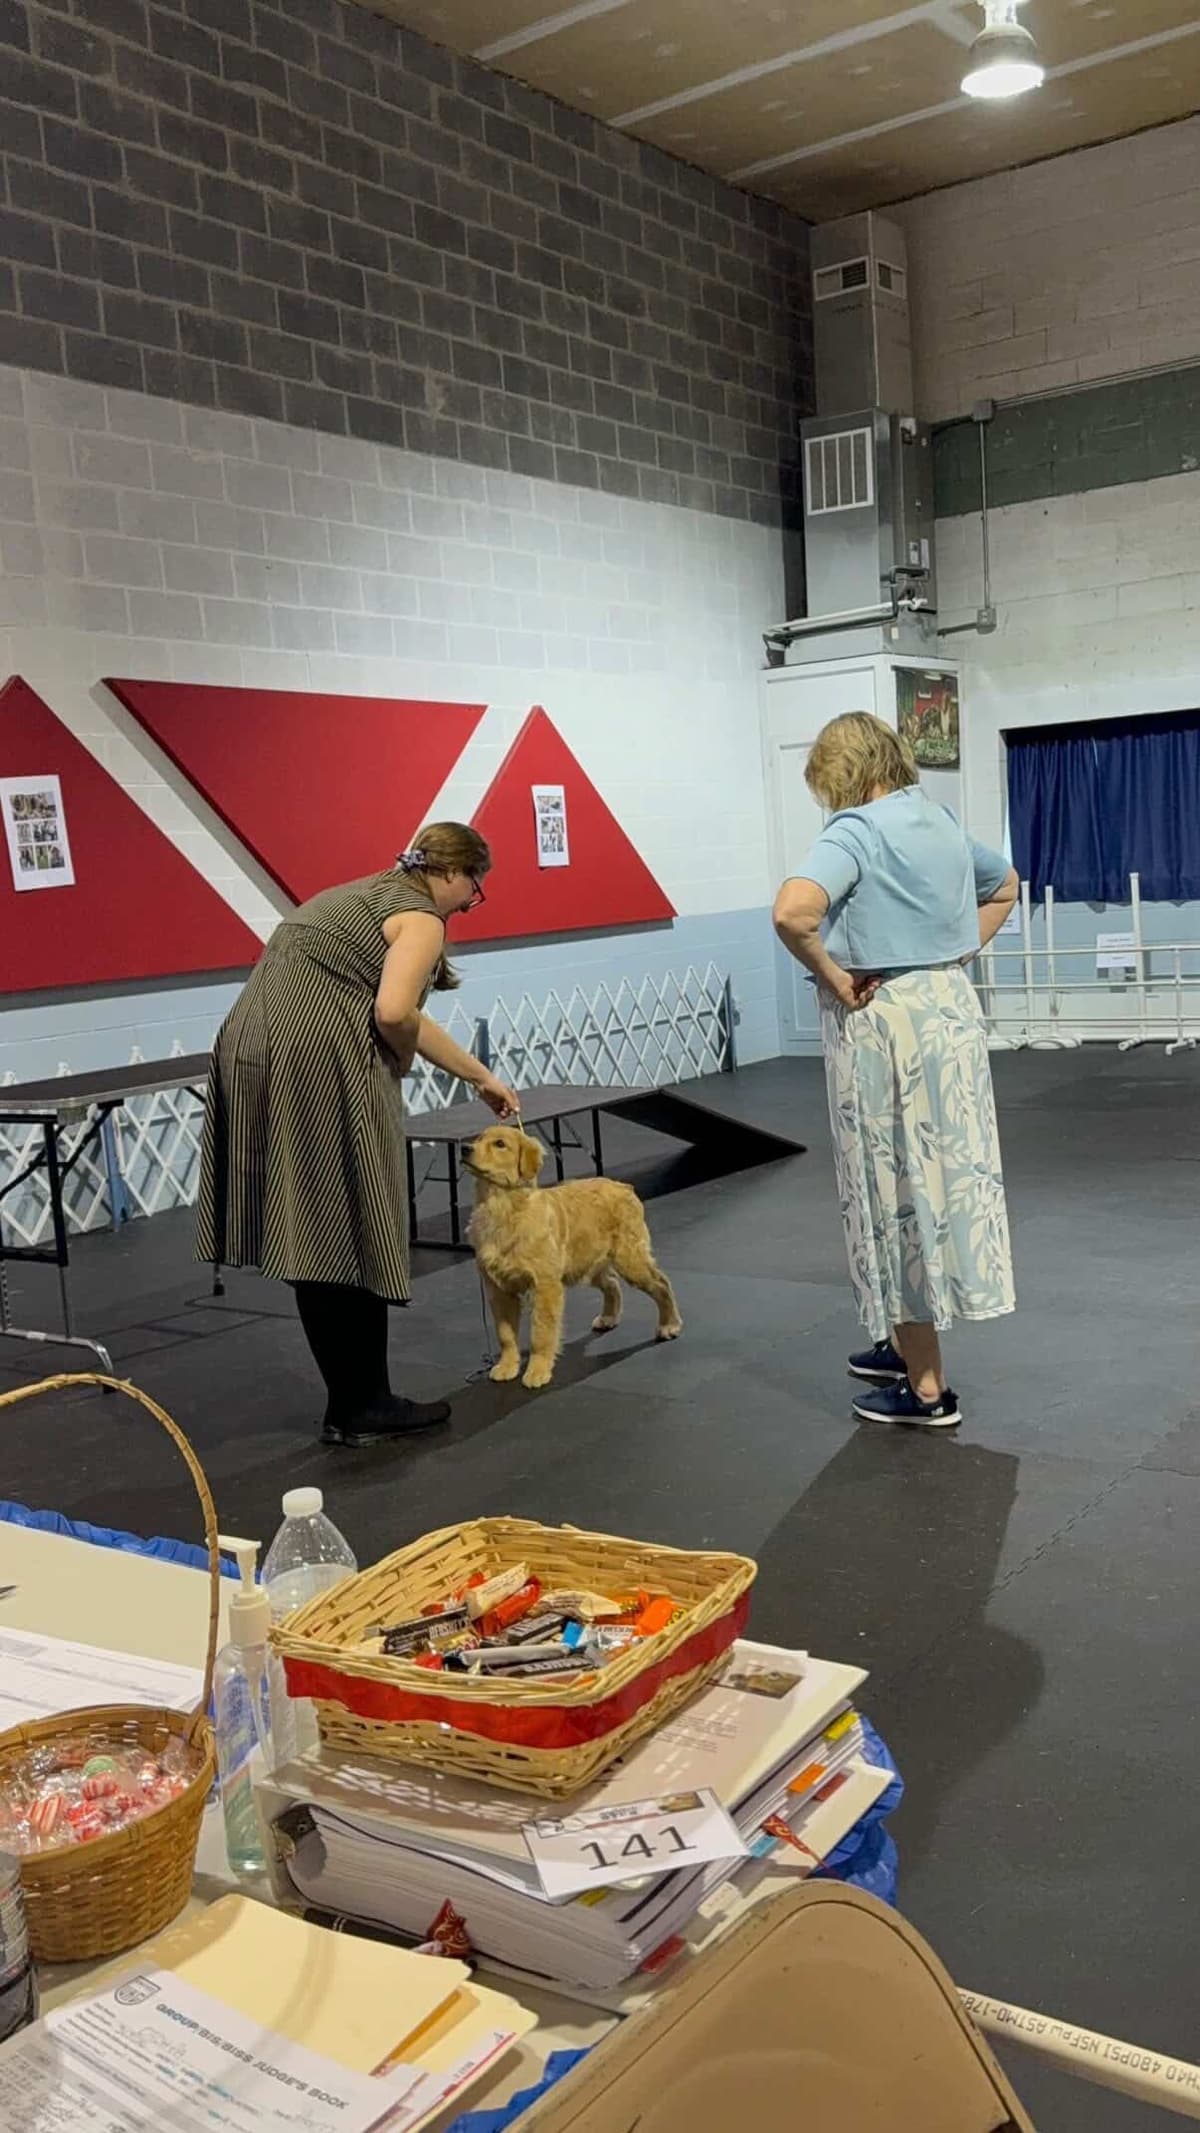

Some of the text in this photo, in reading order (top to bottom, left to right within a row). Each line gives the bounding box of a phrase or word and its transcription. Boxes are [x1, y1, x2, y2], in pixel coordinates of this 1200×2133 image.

[580, 1825, 697, 1871] 141
[1102, 2042, 1162, 2074] 480PSI
[1165, 2064, 1200, 2090] H40
[252, 2061, 309, 2091] JUDGE'S
[307, 2087, 350, 2110] BOOK
